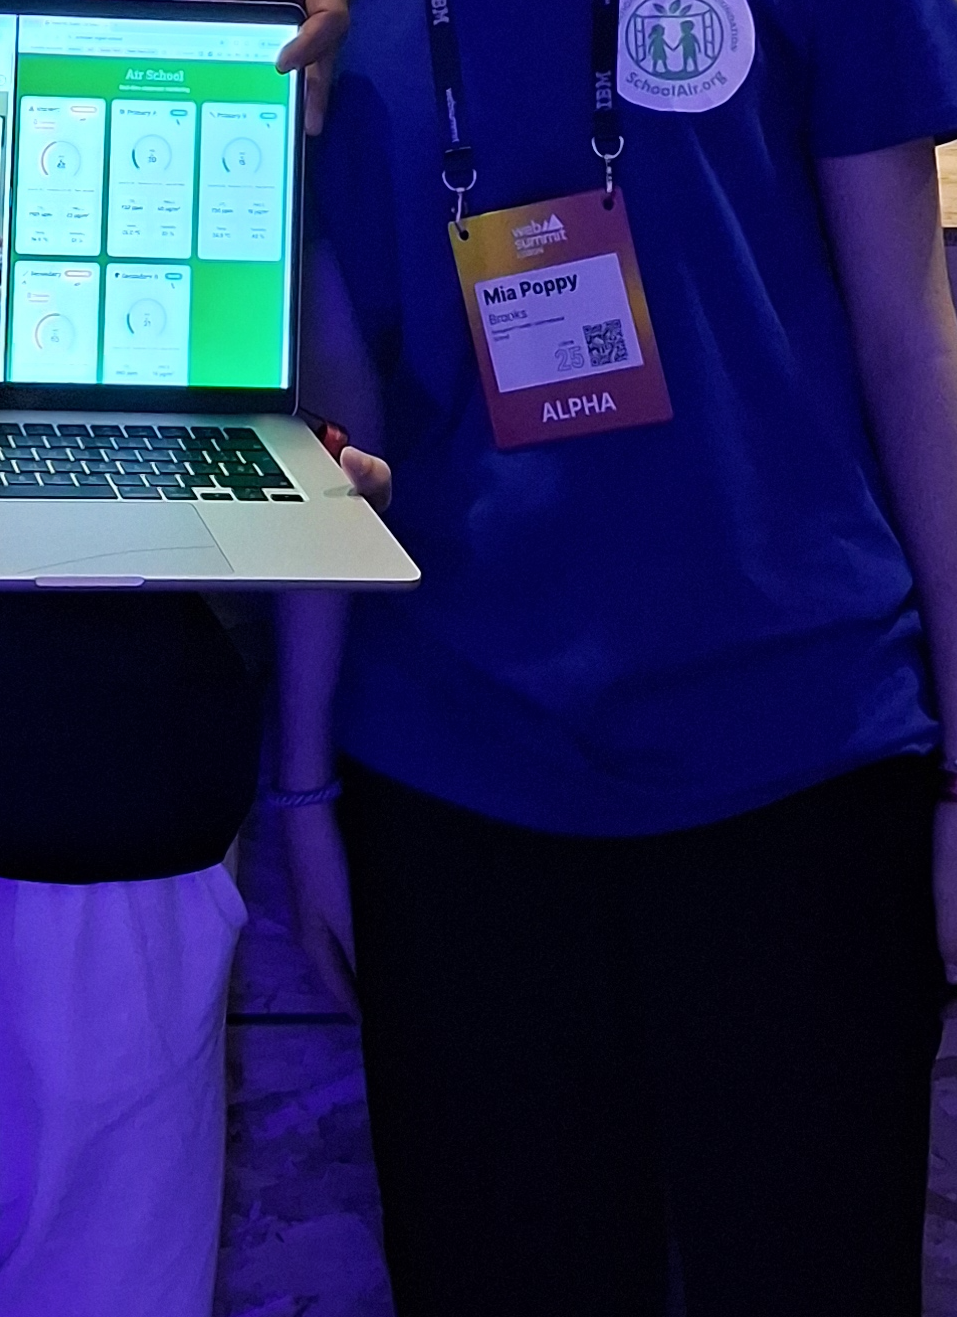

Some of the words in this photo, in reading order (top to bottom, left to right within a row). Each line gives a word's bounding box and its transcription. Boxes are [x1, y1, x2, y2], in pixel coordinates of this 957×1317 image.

[125, 68, 144, 81] Air
[145, 69, 185, 82] School
[625, 70, 728, 97] SchoolAir.org
[596, 70, 613, 110] IBM
[514, 229, 568, 250] summit
[482, 285, 518, 306] Mia
[519, 274, 579, 299] Poppy
[554, 345, 585, 372] 25
[542, 391, 617, 423] ALPHA
